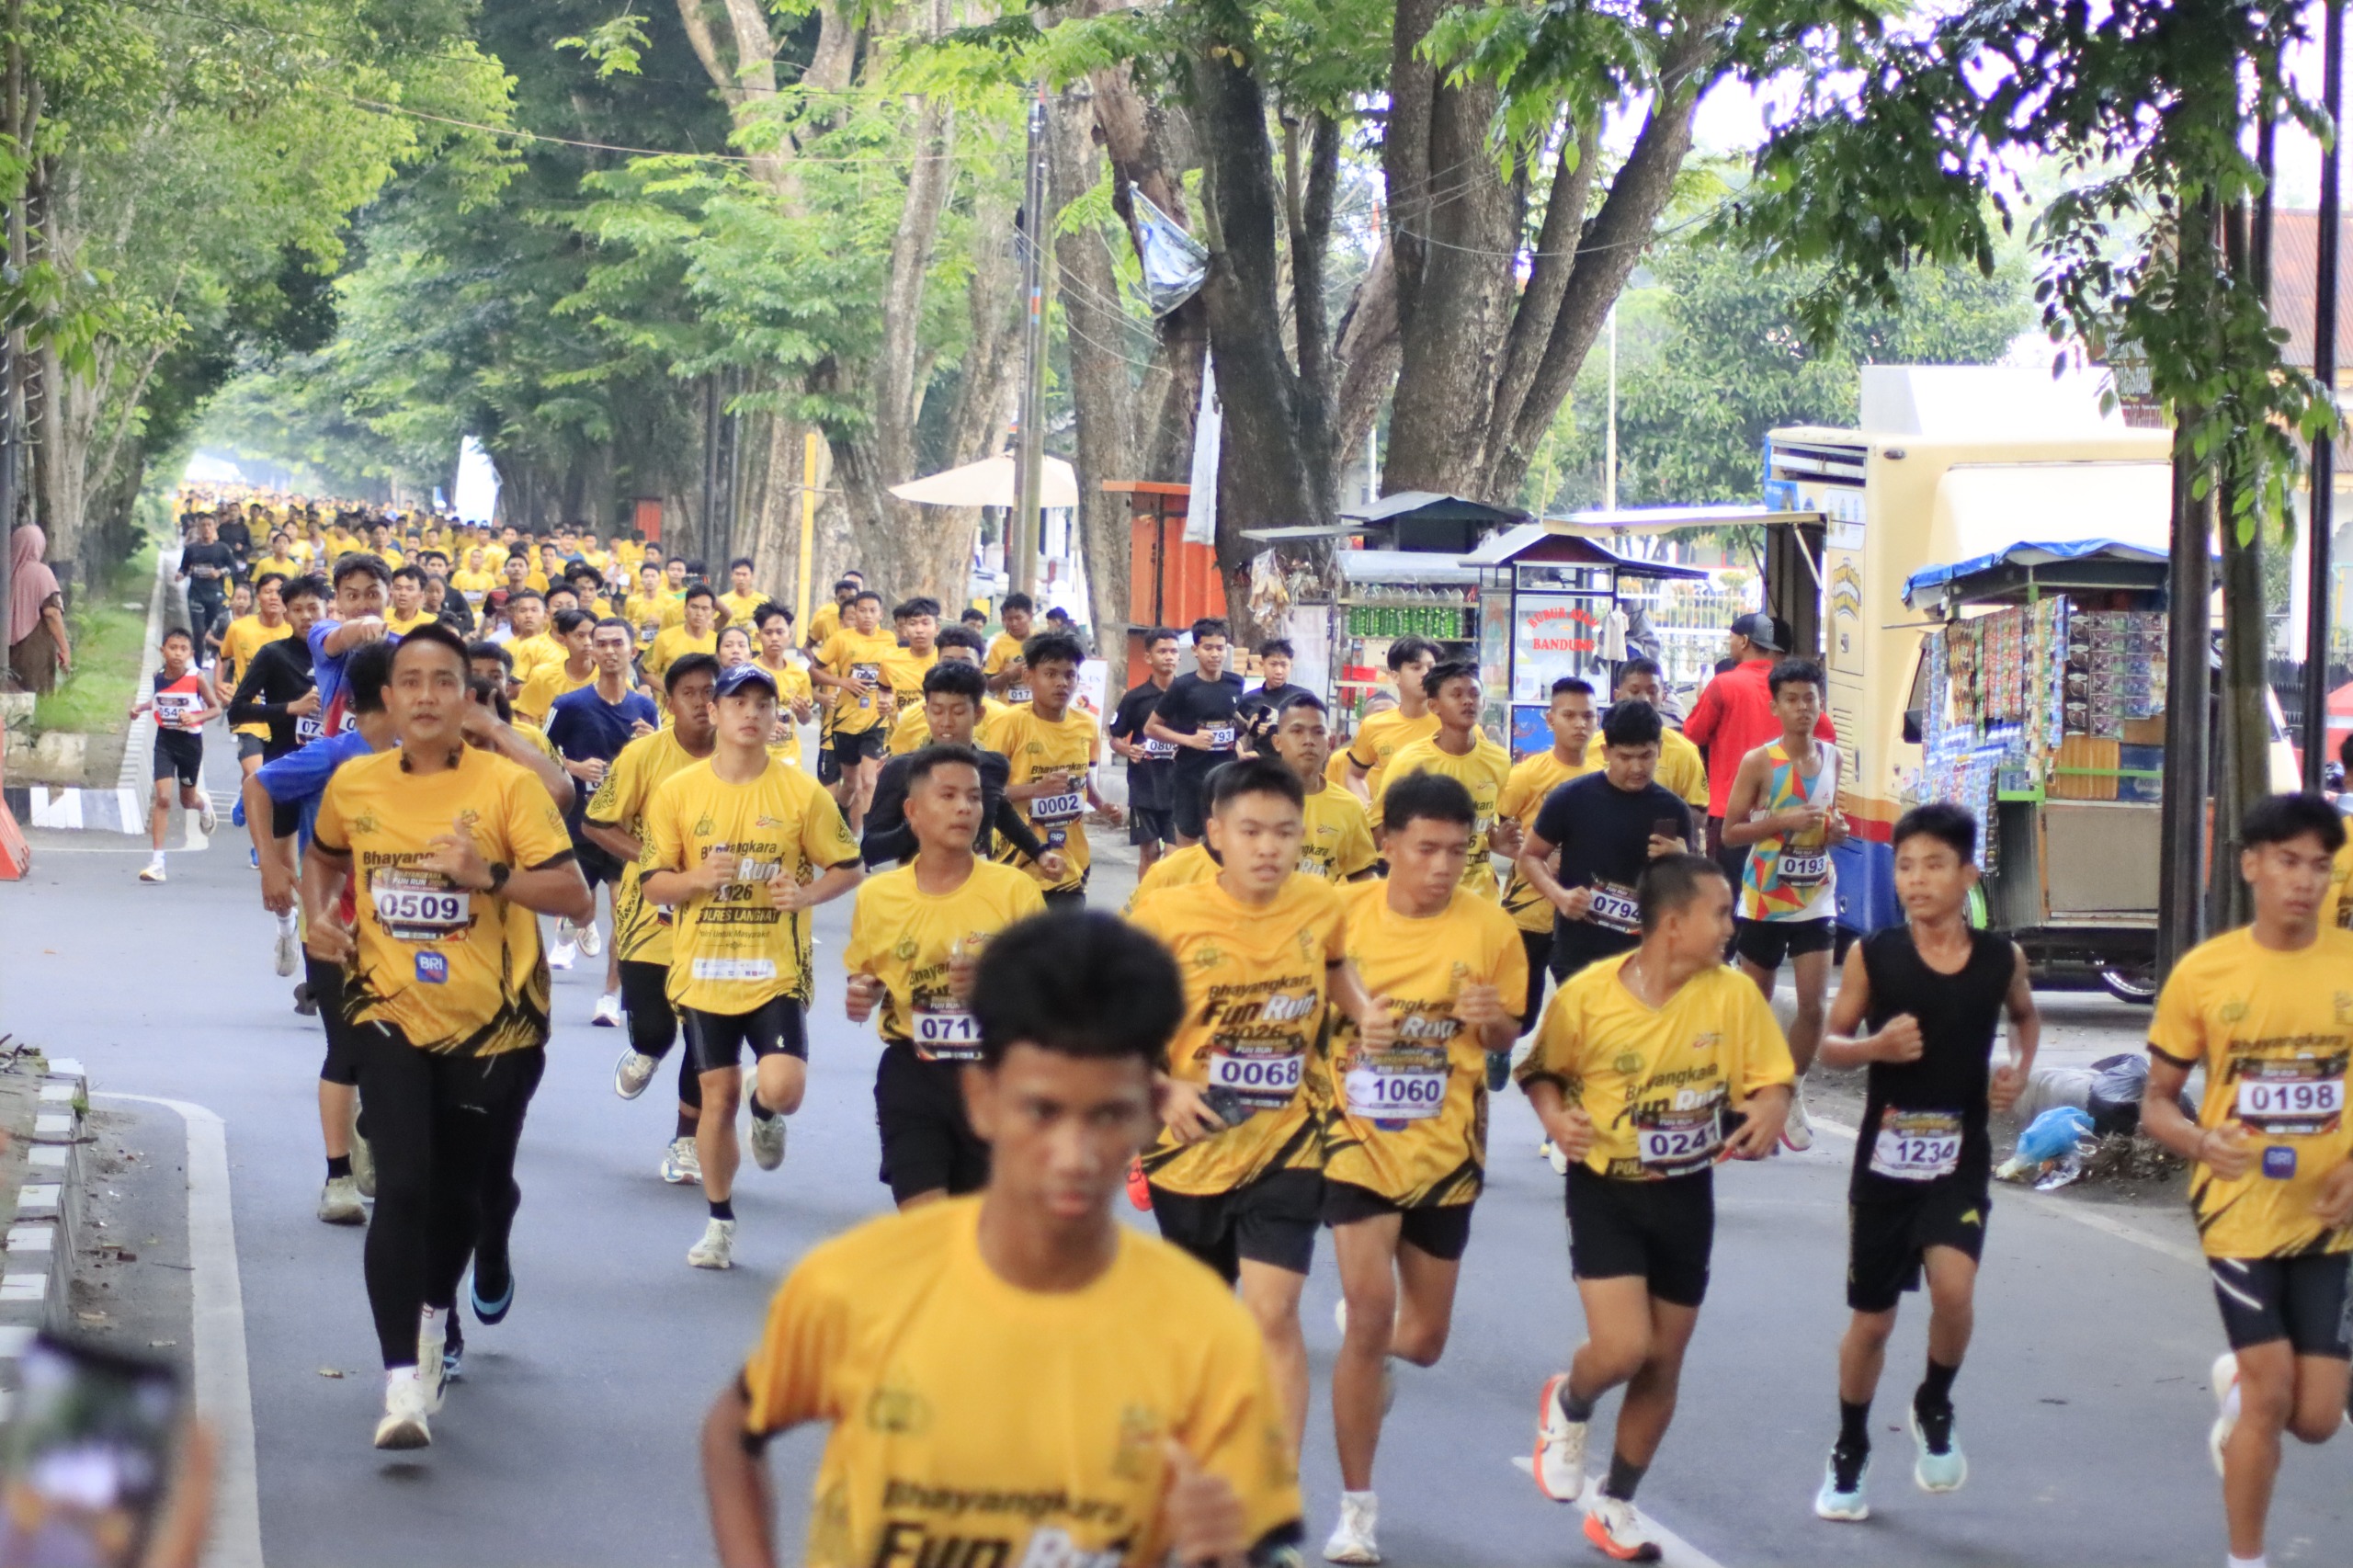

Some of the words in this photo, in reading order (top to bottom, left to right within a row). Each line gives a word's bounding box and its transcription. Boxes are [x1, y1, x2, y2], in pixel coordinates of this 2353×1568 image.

[1527, 608, 1566, 629] BUBUR
[1533, 638, 1596, 652] BANDUNG
[1037, 795, 1079, 815] 0002
[1784, 858, 1824, 874] 0193
[380, 893, 460, 920] 0509
[420, 956, 443, 970] BRI
[1201, 999, 1263, 1026] Fun
[1262, 994, 1316, 1020] Run
[1221, 1060, 1300, 1086] 0068
[1373, 1078, 1440, 1102] 1060
[2251, 1084, 2335, 1111] 0198
[1896, 1140, 1955, 1163] 1234
